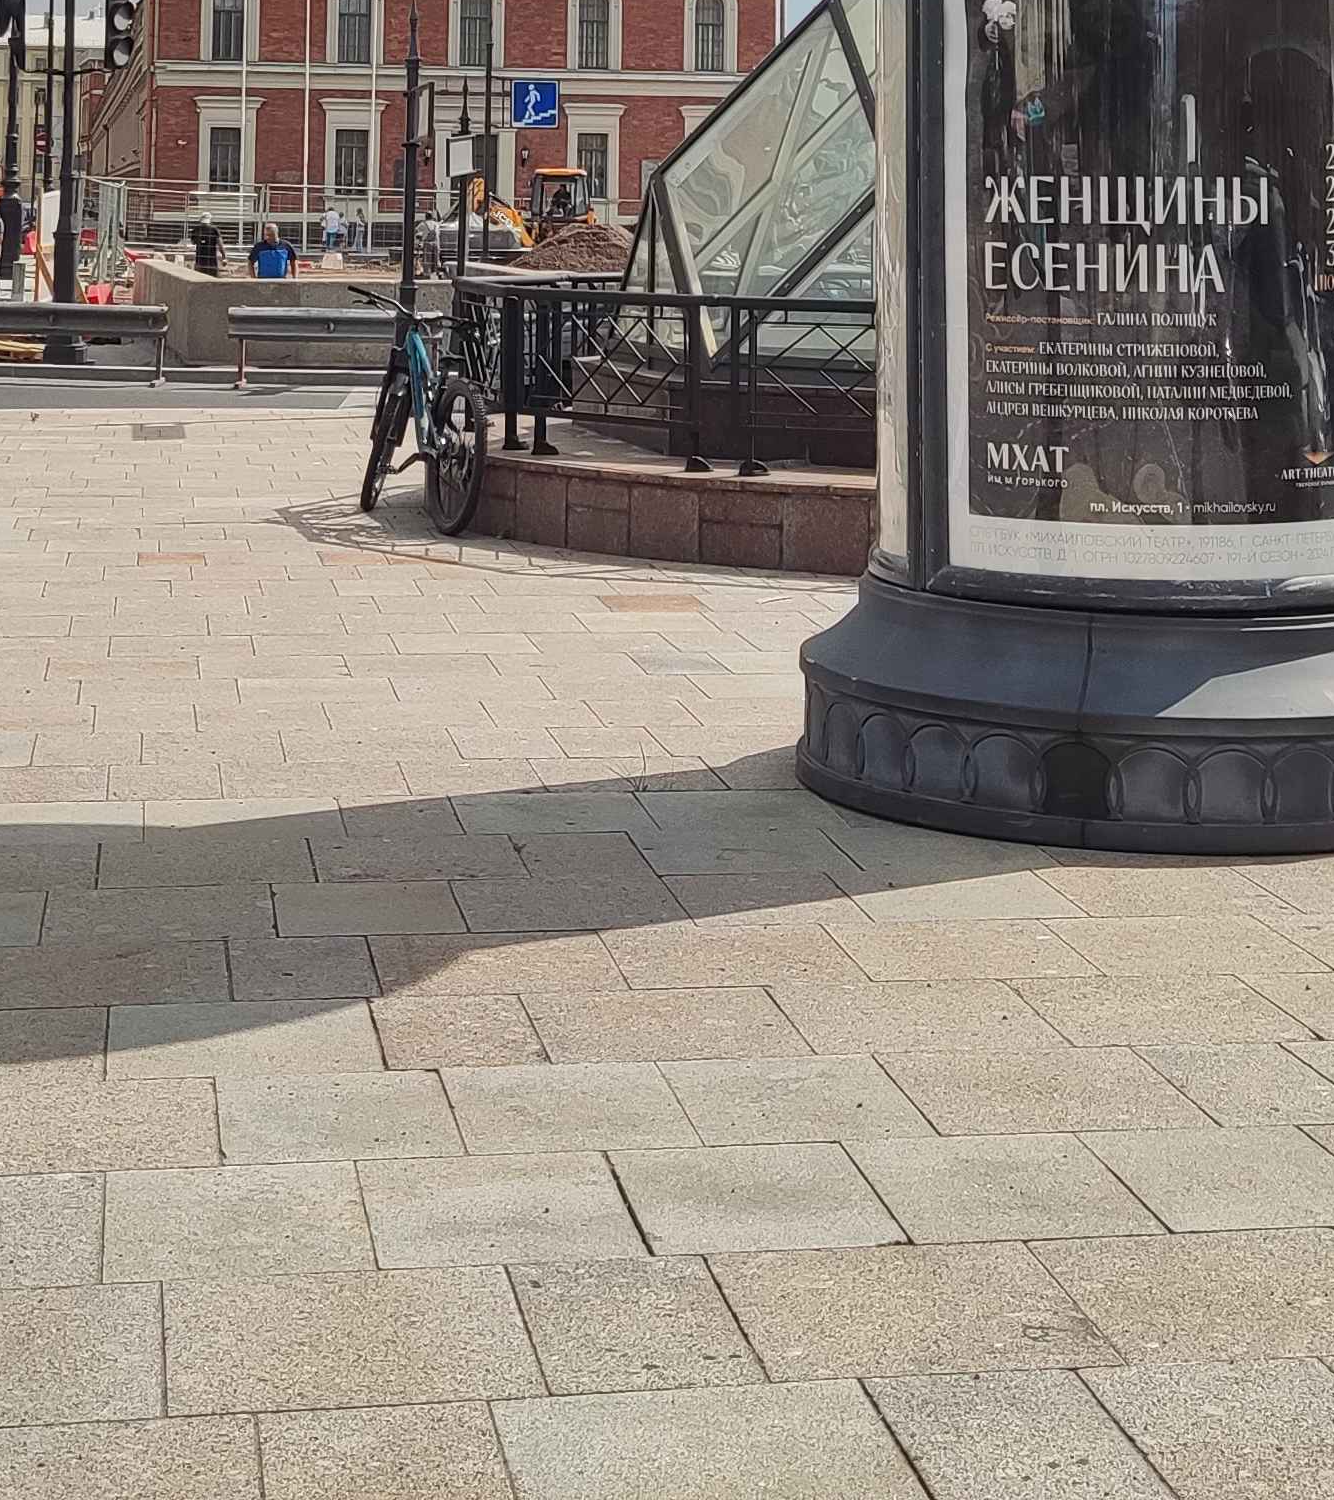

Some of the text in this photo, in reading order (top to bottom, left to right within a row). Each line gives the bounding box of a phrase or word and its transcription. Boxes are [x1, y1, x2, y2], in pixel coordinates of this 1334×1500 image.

[984, 175, 1268, 236] ЖЕНЩИНЫ
[984, 242, 1225, 293] ЕСЕНИНА
[1097, 312, 1147, 326] ГАЛИНА
[1151, 313, 1217, 327] ПОЛИЩУК
[1039, 342, 1113, 356] ЕКАТЕРИНЫ
[1117, 341, 1219, 357] СТРИЖЕНОВОЙ,
[986, 360, 1267, 379] ЕКАТЕРИНЫ ВОЛКОВОЙ, АГНИИ КУЗНЕЦОВОЙ,
[986, 380, 1293, 401] АЛИСЫ ГРЕБЕНЩИКОВОЙ, НАТАЛИИ МЕДВЕДЕВОЙ,
[986, 400, 1259, 421] АНДРЕЯ ВЕШКУРЦЕВА, НИКОЛАЯ КОРОТАЕВА
[987, 442, 1069, 473] МХАТ
[1016, 476, 1068, 488] ГОРЬКОГО
[1090, 502, 1109, 512] пл.
[1112, 502, 1175, 516] Искусств,
[1193, 502, 1276, 515] mikhailovsky.ru
